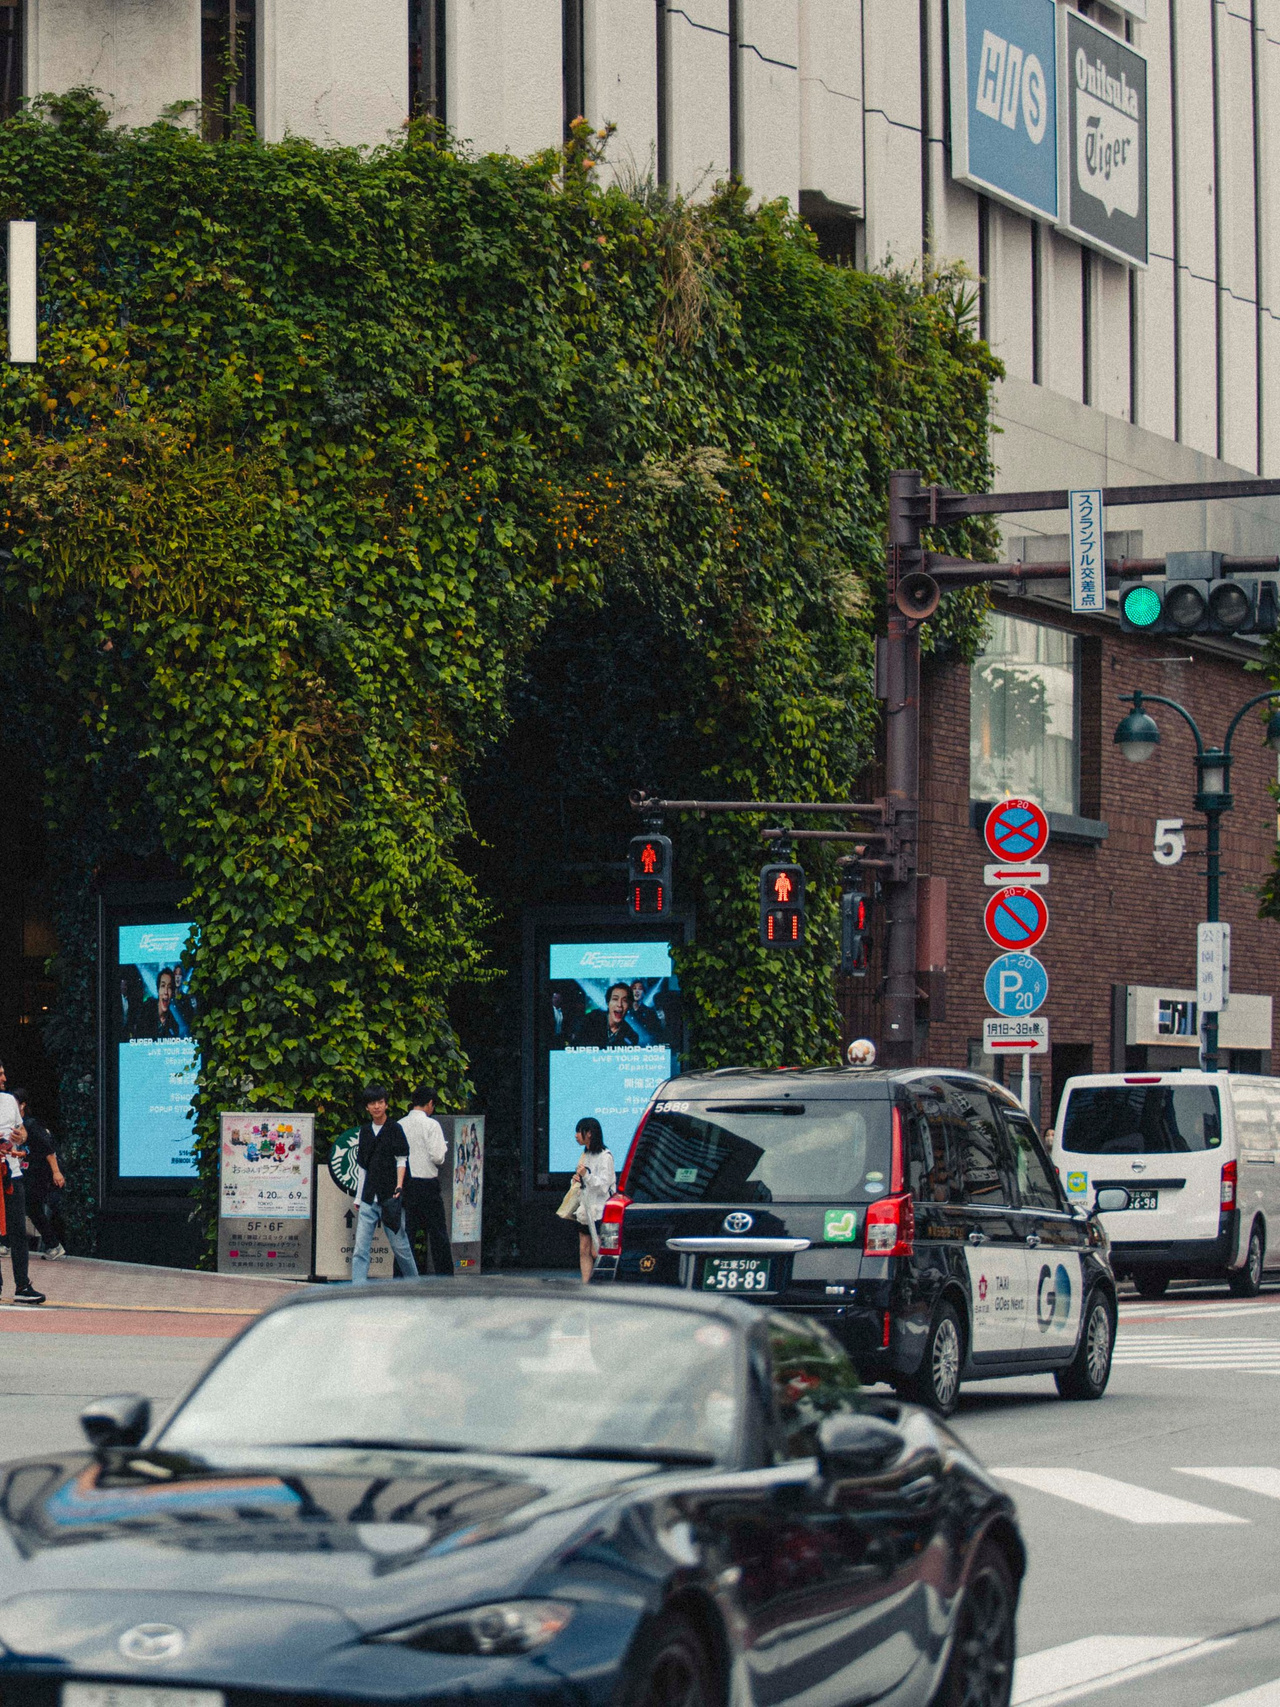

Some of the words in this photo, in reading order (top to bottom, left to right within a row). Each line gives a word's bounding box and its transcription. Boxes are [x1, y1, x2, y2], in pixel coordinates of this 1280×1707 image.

[1075, 47, 1138, 120] Onitsuka
[1086, 115, 1131, 180] Tiger
[1079, 494, 1096, 606] スクランブル交差点
[1152, 818, 1187, 866] 5
[1003, 887, 1029, 898] 20-7
[999, 970, 1023, 1009] P
[1015, 991, 1033, 1010] 20
[564, 1046, 600, 1054] SUPER
[369, 1246, 389, 1254] OURS
[716, 1271, 766, 1289] 58-89
[995, 1276, 1010, 1290] TAXI
[1036, 1264, 1071, 1334] GO
